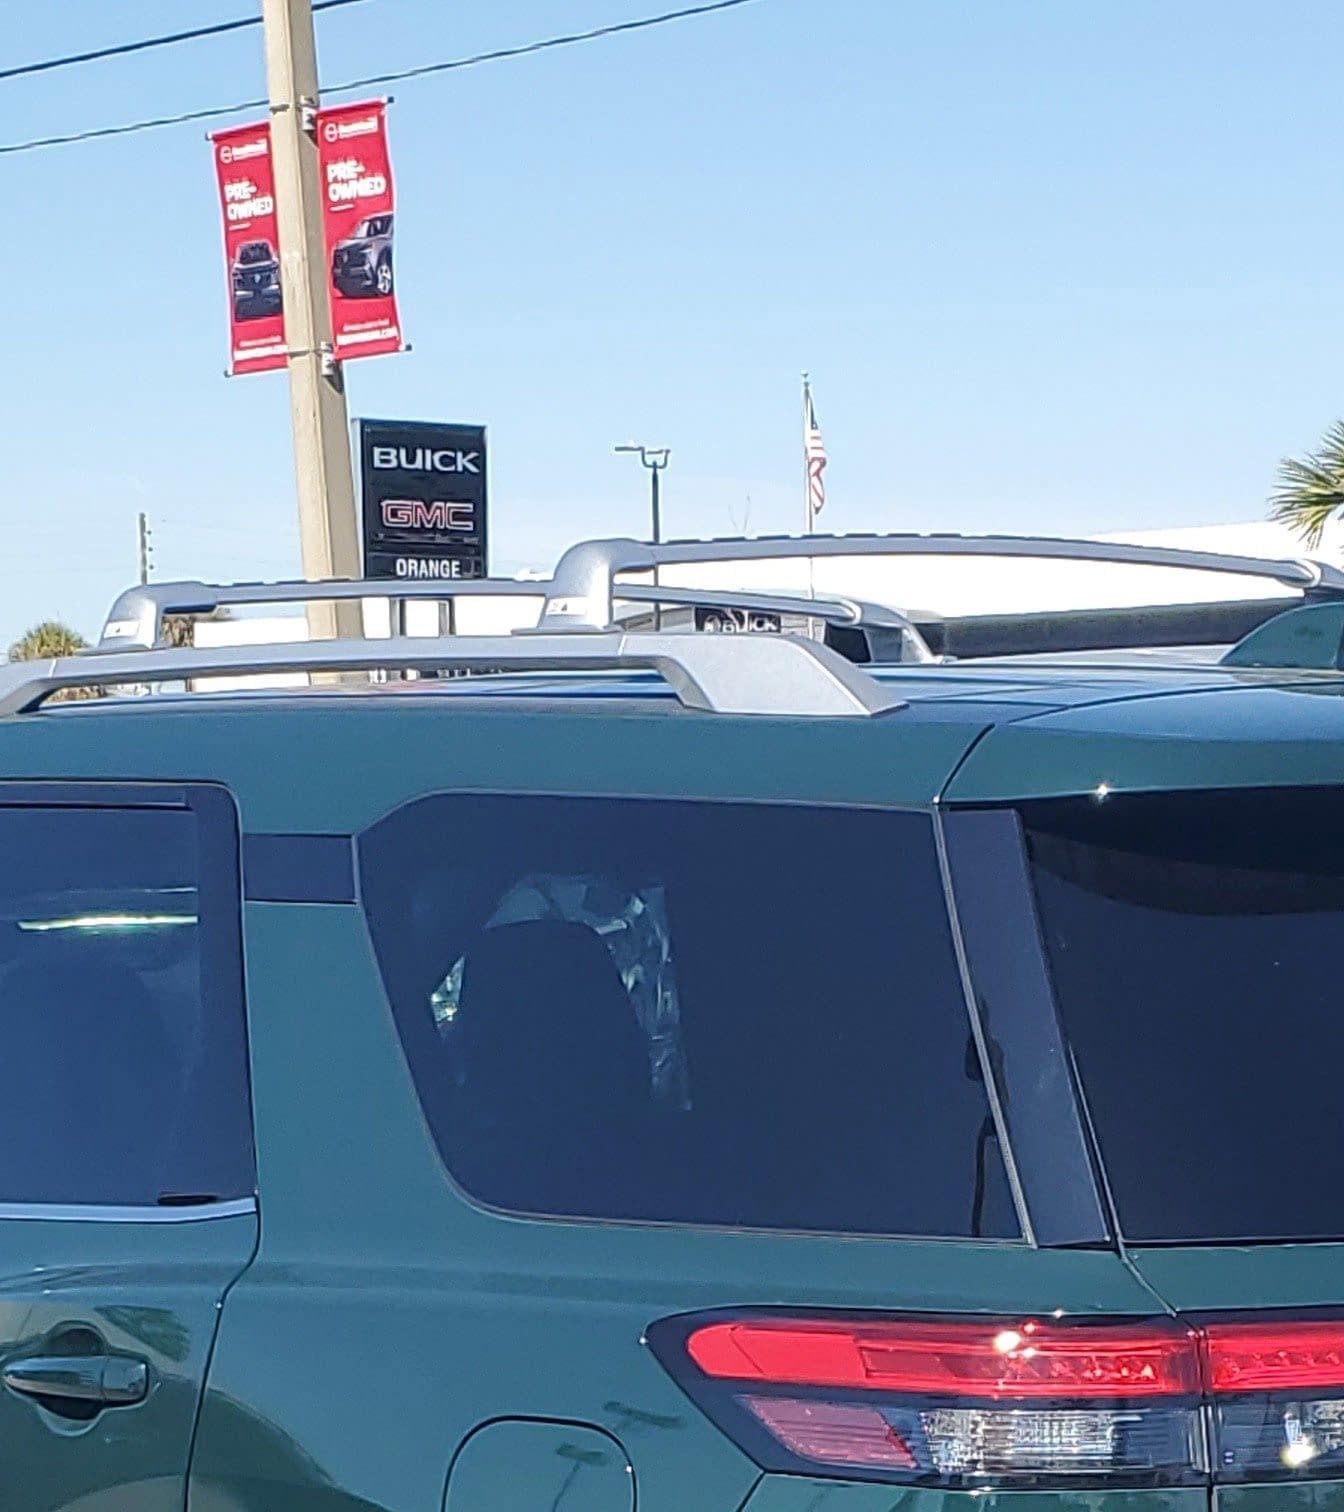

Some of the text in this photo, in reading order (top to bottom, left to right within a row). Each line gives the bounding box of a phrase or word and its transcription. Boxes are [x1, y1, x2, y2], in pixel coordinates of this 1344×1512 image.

[325, 158, 365, 182] PRE-
[328, 175, 387, 202] OWNED
[226, 195, 274, 221] OWNED
[372, 446, 480, 474] BUICK
[380, 499, 474, 531] GMC
[396, 558, 461, 578] ORANGE
